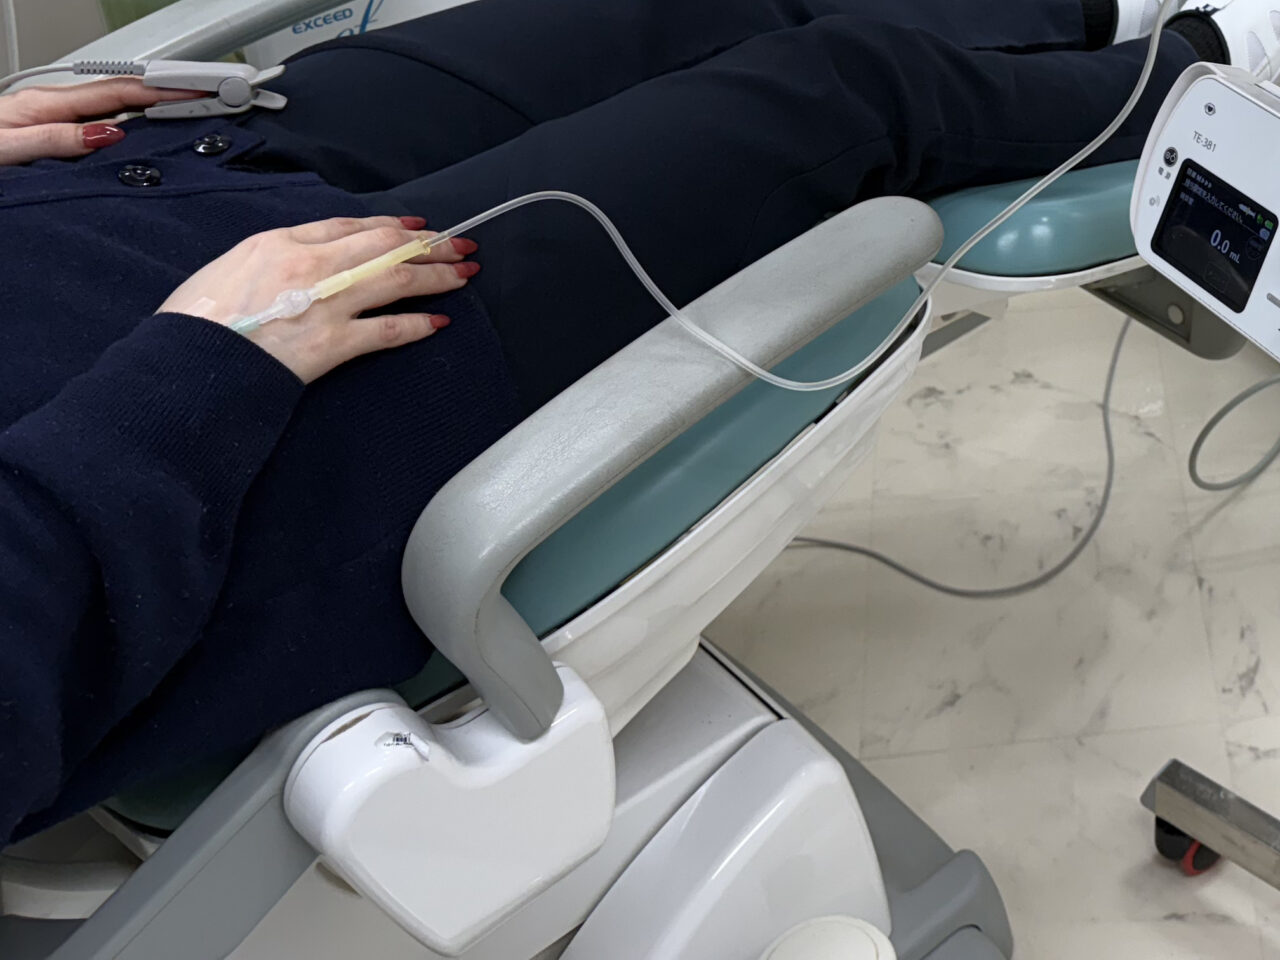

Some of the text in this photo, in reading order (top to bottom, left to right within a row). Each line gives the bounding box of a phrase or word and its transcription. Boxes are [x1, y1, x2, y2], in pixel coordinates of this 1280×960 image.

[292, 8, 353, 34] EXCEED
[1193, 131, 1217, 152] TE-381
[1210, 229, 1241, 264] 0.0 mL
